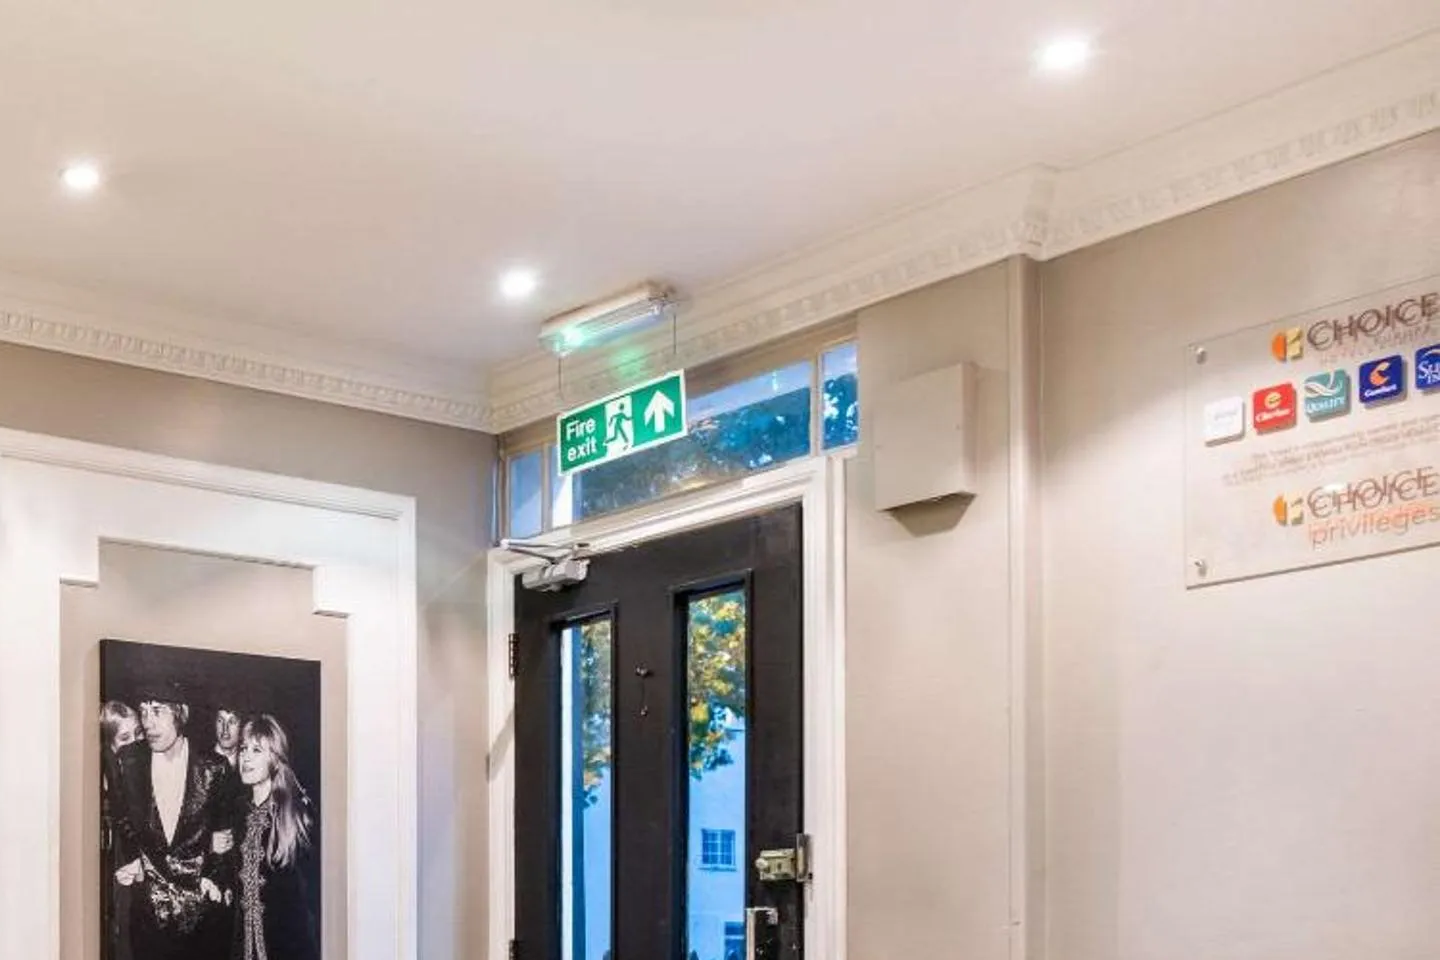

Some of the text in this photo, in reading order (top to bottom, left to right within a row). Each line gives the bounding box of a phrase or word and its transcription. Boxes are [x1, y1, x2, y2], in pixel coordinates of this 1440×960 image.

[1306, 292, 1439, 350] CHOICE
[566, 416, 596, 441] Fire
[567, 436, 597, 462] exit
[1307, 466, 1440, 519] CHOICE
[1308, 502, 1440, 550] privileges
